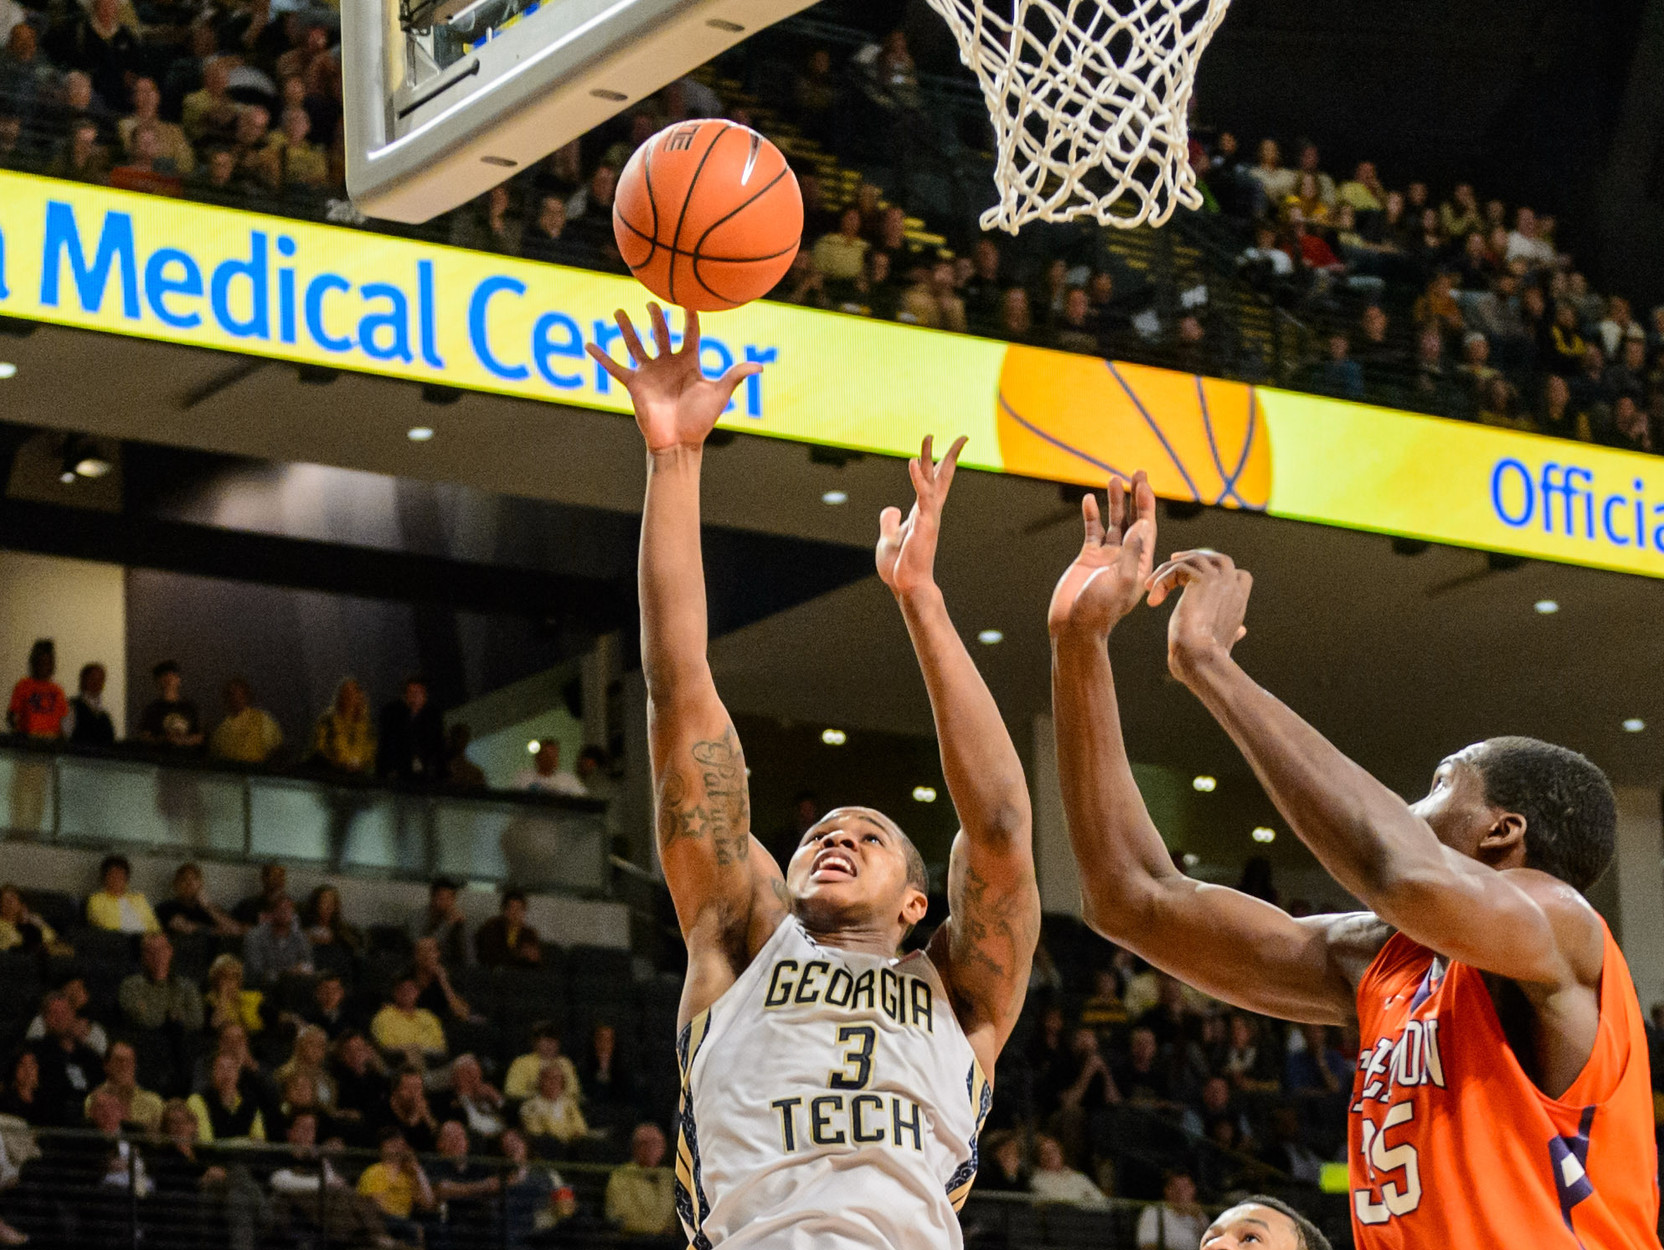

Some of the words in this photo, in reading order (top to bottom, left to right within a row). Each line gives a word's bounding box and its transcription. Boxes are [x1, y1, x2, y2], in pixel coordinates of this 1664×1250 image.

[40, 199, 446, 370] Medical
[764, 959, 935, 1034] GEORGIA
[828, 1021, 878, 1091] 3
[771, 1094, 923, 1152] TECH
